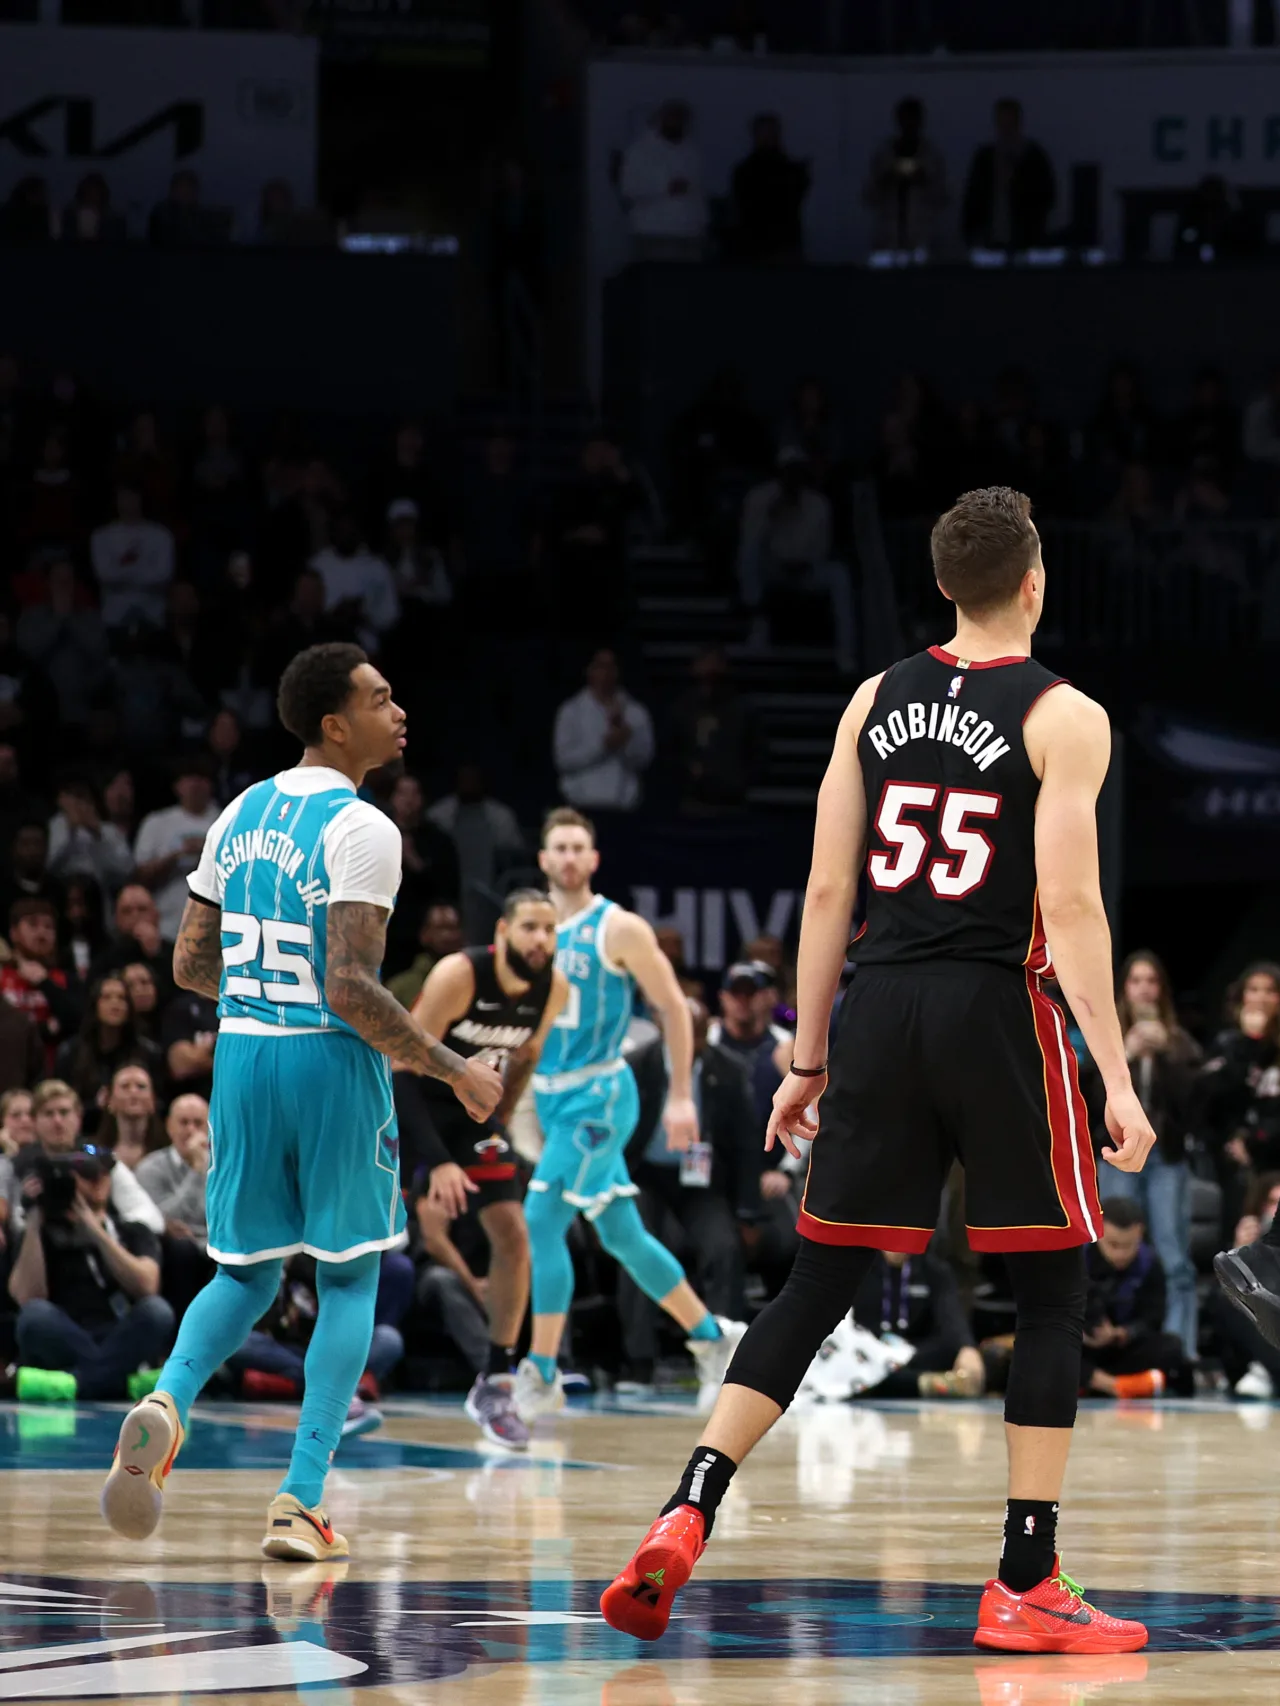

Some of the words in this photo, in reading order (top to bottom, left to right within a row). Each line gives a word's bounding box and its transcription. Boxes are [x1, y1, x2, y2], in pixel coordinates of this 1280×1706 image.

[867, 702, 1012, 773] ROBINSON
[216, 829, 305, 899] ASHINGTON
[867, 779, 1003, 901] 55
[220, 911, 321, 1005] 25
[628, 882, 806, 972] HIV
